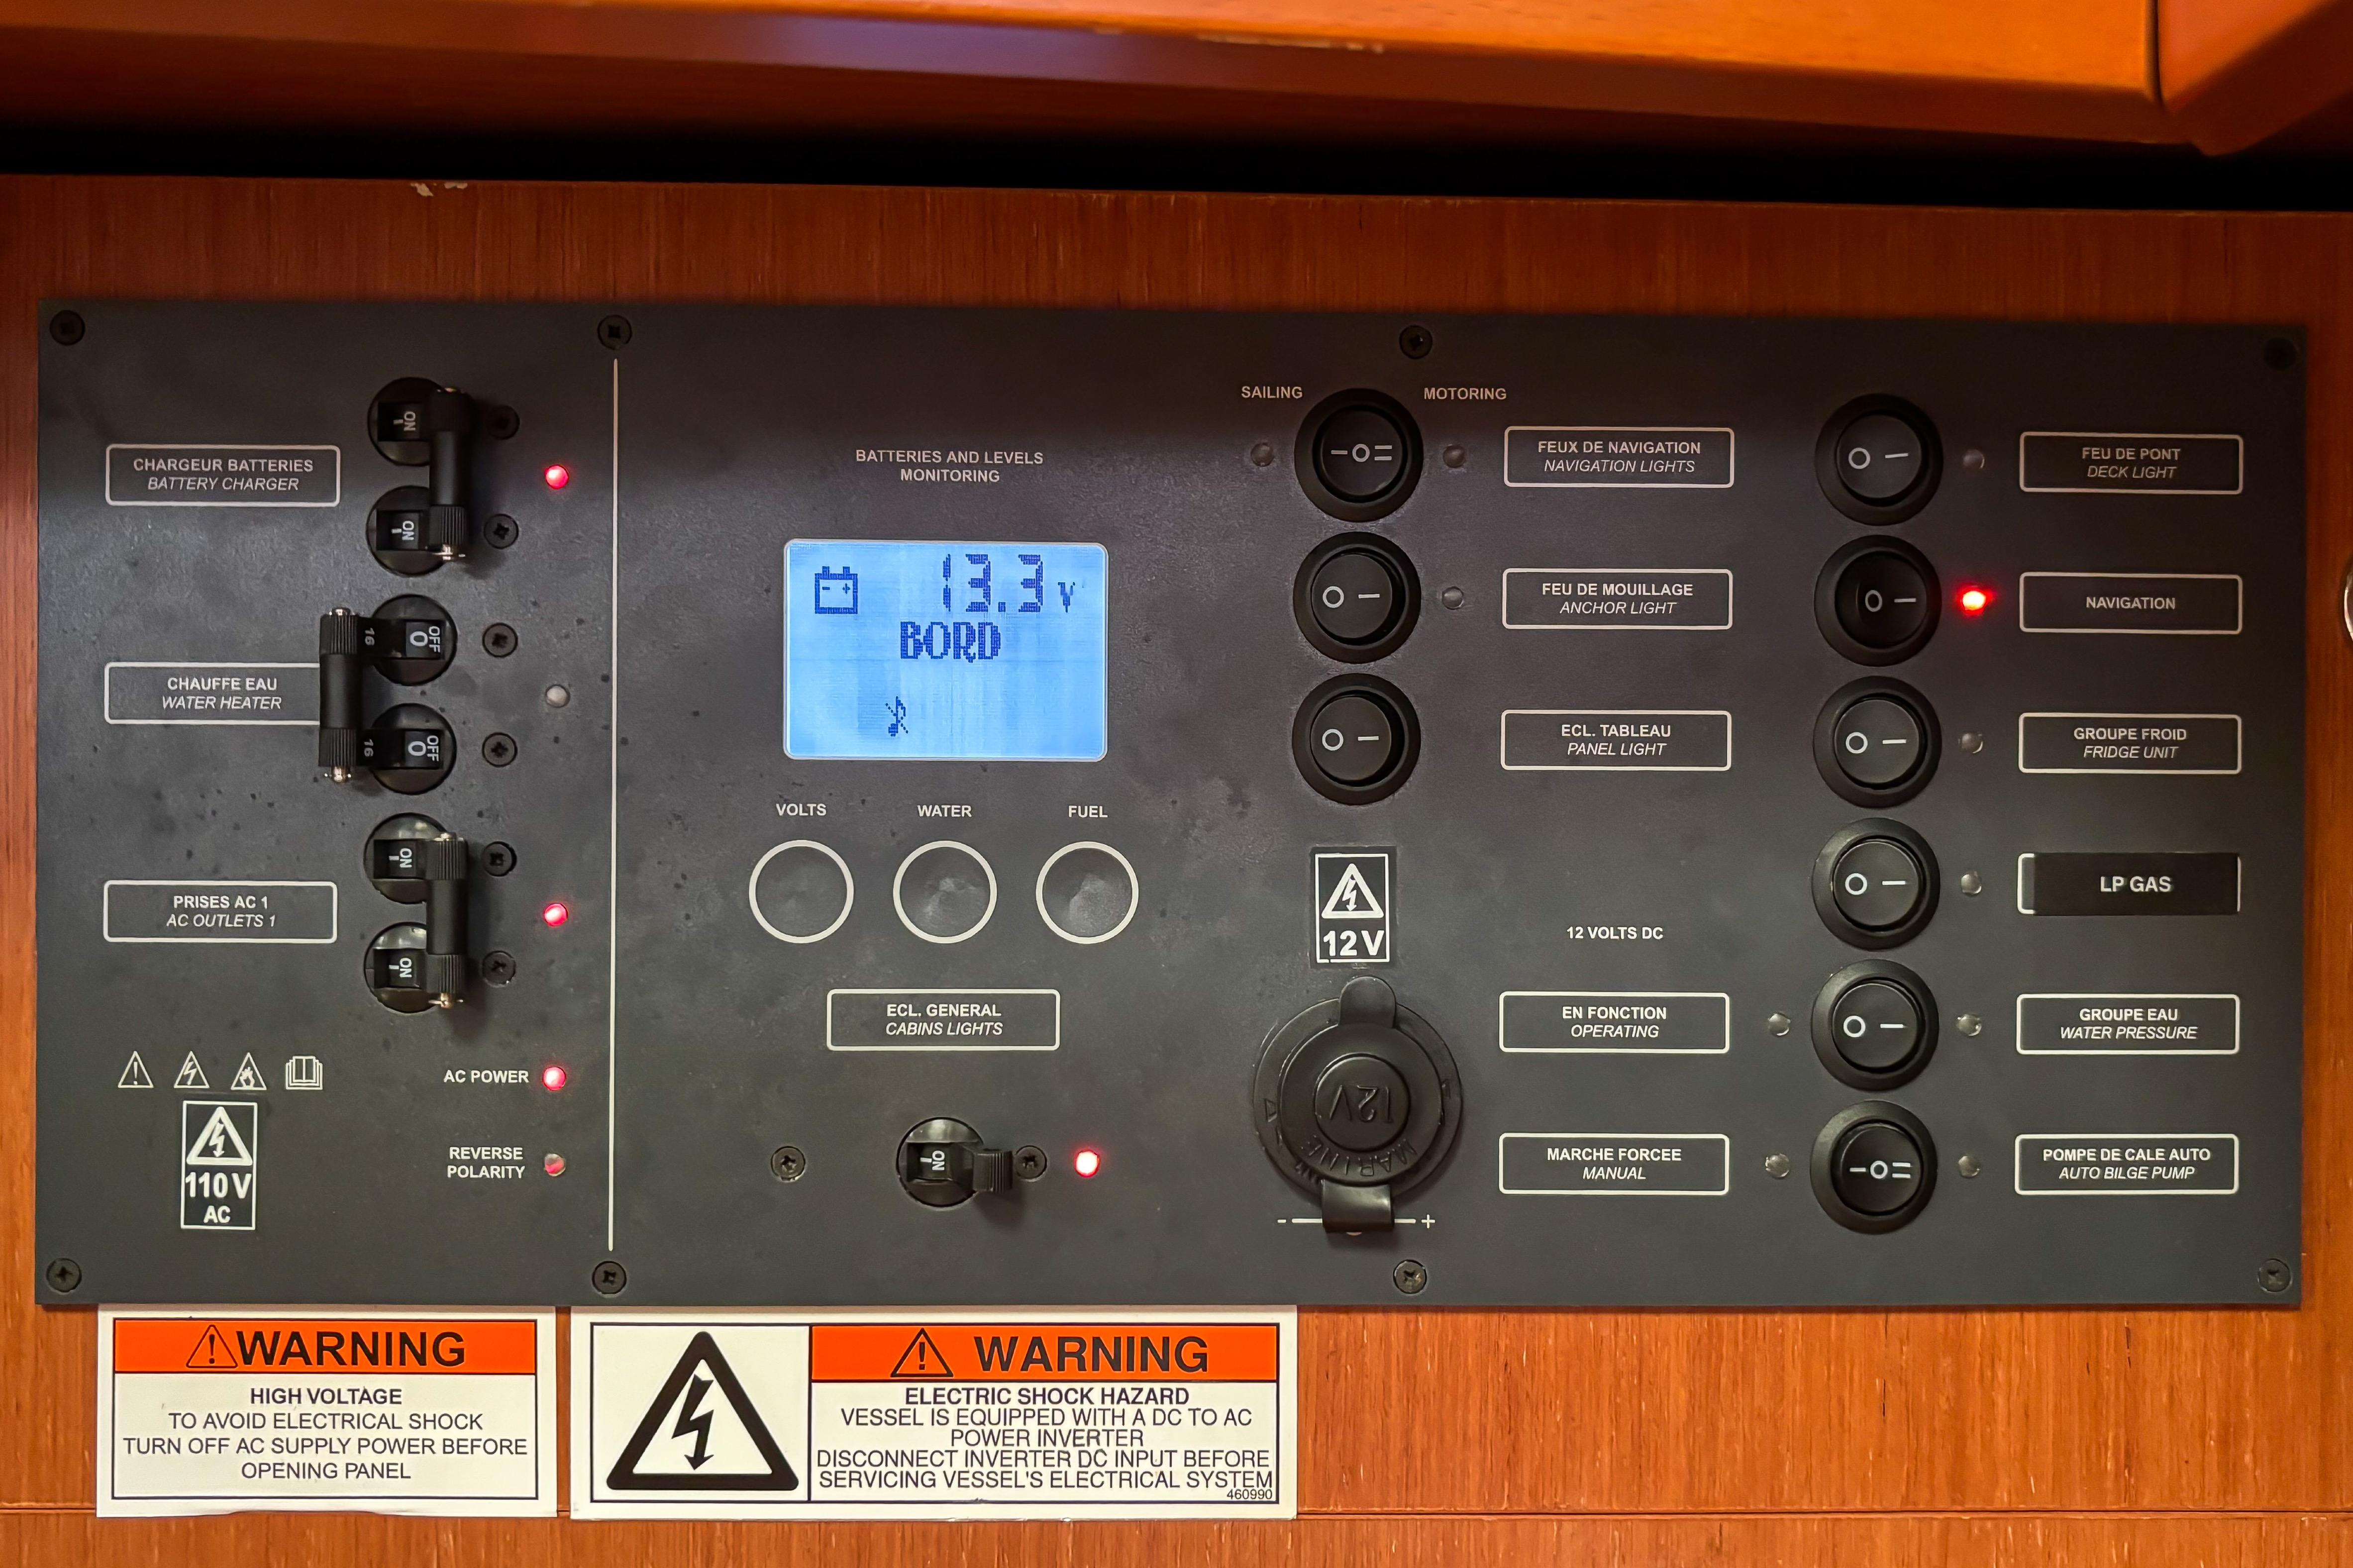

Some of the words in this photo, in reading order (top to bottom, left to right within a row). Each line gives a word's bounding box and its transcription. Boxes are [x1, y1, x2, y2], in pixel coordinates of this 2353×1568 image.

[1241, 386, 1302, 398] SAILING
[1425, 388, 1506, 399] MOTORING
[404, 411, 415, 430] ON
[1538, 441, 1578, 453] FEUX
[1584, 442, 1603, 453] DE
[1609, 442, 1700, 454] NAVIGATION
[2082, 448, 2110, 459] FEU
[2116, 449, 2136, 459] DE
[2141, 449, 2180, 460] PONT
[856, 450, 941, 463] BATTERIES
[946, 451, 979, 463] AND
[985, 452, 1043, 464] LEVELS
[134, 459, 222, 472] CHARGEUR
[228, 459, 312, 472] BATTERIES
[1544, 460, 1636, 472] NAVIGATION
[1640, 460, 1695, 472] LIGHTS
[2087, 466, 2128, 478] DECK
[2133, 467, 2177, 478] LIGHT
[901, 469, 999, 482] MONITORING
[148, 477, 218, 490] BATTERY
[222, 478, 299, 490] CHARGER
[403, 521, 414, 540] ON
[943, 554, 1043, 613] 13.3
[1543, 584, 1571, 595] FEU
[1578, 584, 1597, 595] DE
[1603, 584, 1693, 595] MOUILLAGE
[1560, 602, 1626, 613] ANCHOR
[1631, 602, 1677, 614] LIGHT
[2086, 597, 2175, 609] NAVIGATION
[365, 628, 374, 645] 16
[429, 626, 440, 652] OFF
[901, 621, 1001, 663] BORD
[168, 677, 241, 690] CHAUFFE
[246, 678, 277, 690] EAU
[163, 696, 216, 709] WATER
[220, 696, 281, 709] HEATER
[1562, 725, 1595, 736] ECL.
[1600, 725, 1670, 737] TABLEAU
[2074, 728, 2137, 739] GROUPE
[2142, 729, 2186, 740] FROID
[364, 739, 373, 756] 16
[427, 736, 439, 761] OFF
[1568, 743, 1616, 755] PANEL
[1621, 743, 1667, 755] LIGHT
[2084, 746, 2140, 758] FRIDGE
[2144, 747, 2179, 758] UNIT
[776, 803, 826, 815] VOLTS
[918, 805, 971, 817] WATER
[1069, 806, 1108, 817] FUEL
[400, 848, 412, 868] ON
[2101, 877, 2124, 891] LP
[2130, 876, 2171, 892] GAS
[174, 895, 229, 908] PRISES
[235, 895, 256, 908] AC
[261, 896, 267, 909] 1
[167, 914, 188, 926] AC
[194, 914, 263, 927] OUTLETS
[270, 915, 275, 927] 1
[1567, 927, 1583, 939] 12
[1587, 927, 1637, 939] VOLTS
[1642, 927, 1663, 939] DC
[400, 958, 411, 978] ON
[887, 1004, 921, 1016] ECL.
[926, 1004, 1001, 1016] GENERAL
[1563, 1007, 1582, 1018] EN
[1588, 1007, 1666, 1019] FONCTION
[2080, 1008, 2143, 1020] GROUPE
[2148, 1009, 2177, 1020] EAU
[886, 1022, 943, 1035] CABINS
[947, 1022, 1003, 1035] LIGHTS
[1571, 1025, 1659, 1038] OPERATING
[2061, 1026, 2112, 1039] WATER
[2116, 1026, 2198, 1039] PRESSURE
[444, 1070, 465, 1082] AC
[471, 1071, 529, 1082] POWER
[1330, 1084, 1394, 1123] 12V
[450, 1147, 523, 1160] REVERSE
[1548, 1148, 1614, 1160] MARCHE
[1619, 1149, 1681, 1161] FORCEE
[2044, 1149, 2096, 1161] POMPE
[2101, 1149, 2122, 1161] DE
[2125, 1149, 2165, 1161] CALE
[2169, 1148, 2210, 1160] AUTO
[932, 1151, 944, 1170] ON
[448, 1166, 525, 1178] POLARITY
[1583, 1167, 1646, 1179] MANUAL
[2059, 1167, 2100, 1179] AUTO
[2104, 1167, 2148, 1179] BILGE
[2151, 1167, 2195, 1178] PUMP
[204, 1206, 230, 1223] AC
[236, 1331, 464, 1367] WARNING
[974, 1336, 1207, 1372] WARNING
[251, 1388, 301, 1404] HIGH
[307, 1388, 402, 1404] VOLTAGE
[906, 1387, 1011, 1404] ELECTRIC
[1018, 1387, 1094, 1404] SHOCK
[1102, 1387, 1189, 1404] HAZARD
[168, 1413, 196, 1429] TO
[203, 1413, 266, 1429] AVOID
[274, 1413, 403, 1429] ELECTRICAL
[409, 1413, 483, 1430] SHOCK
[841, 1408, 923, 1426] VESSEL
[931, 1408, 949, 1426] IS
[957, 1408, 1065, 1426] EQUIPPED
[1072, 1408, 1125, 1426] WITH
[1132, 1408, 1145, 1426] A
[1153, 1408, 1181, 1425] DC
[1188, 1408, 1217, 1426] TO
[1224, 1409, 1251, 1426] AC
[951, 1429, 1030, 1447] POWER
[1038, 1429, 1143, 1447] INVERTER
[123, 1438, 181, 1454] TURN
[190, 1438, 230, 1454] OFF
[236, 1438, 264, 1454] AC
[272, 1438, 351, 1454] SUPPLY
[358, 1438, 436, 1454] POWER
[443, 1438, 527, 1455] BEFORE
[818, 1450, 958, 1467] DISCONNECT
[965, 1450, 1071, 1468] INVERTER
[1078, 1449, 1107, 1468] DC
[1116, 1450, 1177, 1468] INPUT
[1184, 1450, 1269, 1468] BEFORE
[242, 1462, 337, 1479] OPENING
[346, 1463, 410, 1478] PANEL
[819, 1470, 935, 1488] SERVICING
[943, 1470, 1042, 1488] VESSEL'S
[1051, 1470, 1180, 1488] ELECTRICAL
[1187, 1471, 1272, 1488] SYSTEM
[1227, 1489, 1272, 1499] 460990
